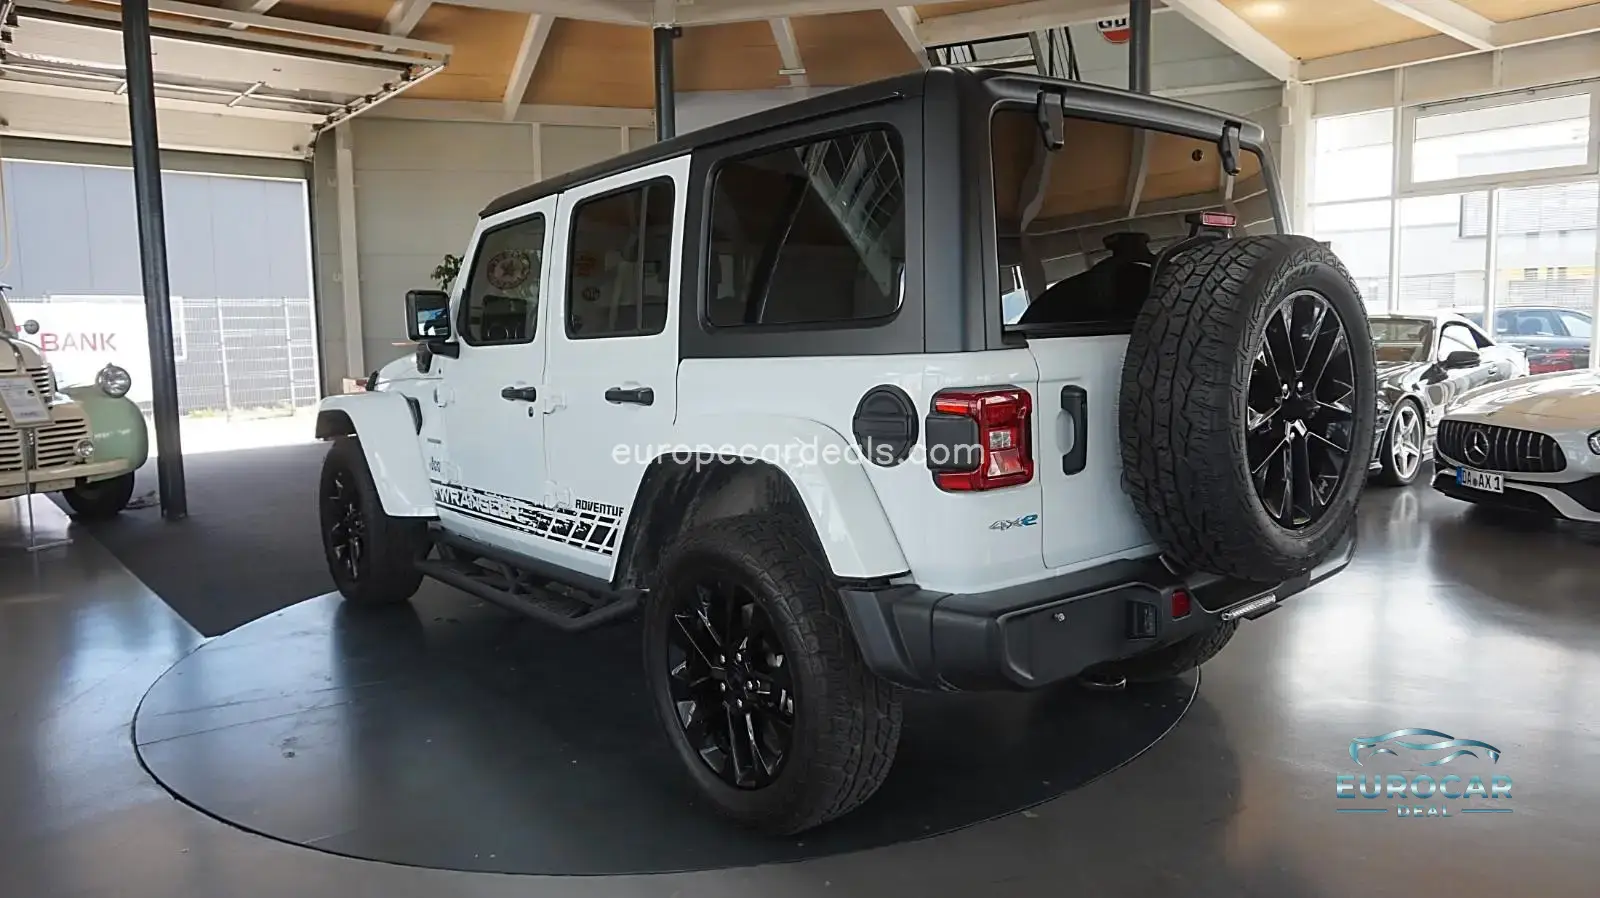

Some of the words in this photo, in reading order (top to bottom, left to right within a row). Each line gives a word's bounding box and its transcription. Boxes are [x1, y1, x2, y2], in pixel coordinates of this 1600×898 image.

[40, 332, 117, 352] BANK
[1479, 474, 1491, 489] AX
[1494, 476, 1501, 491] 1
